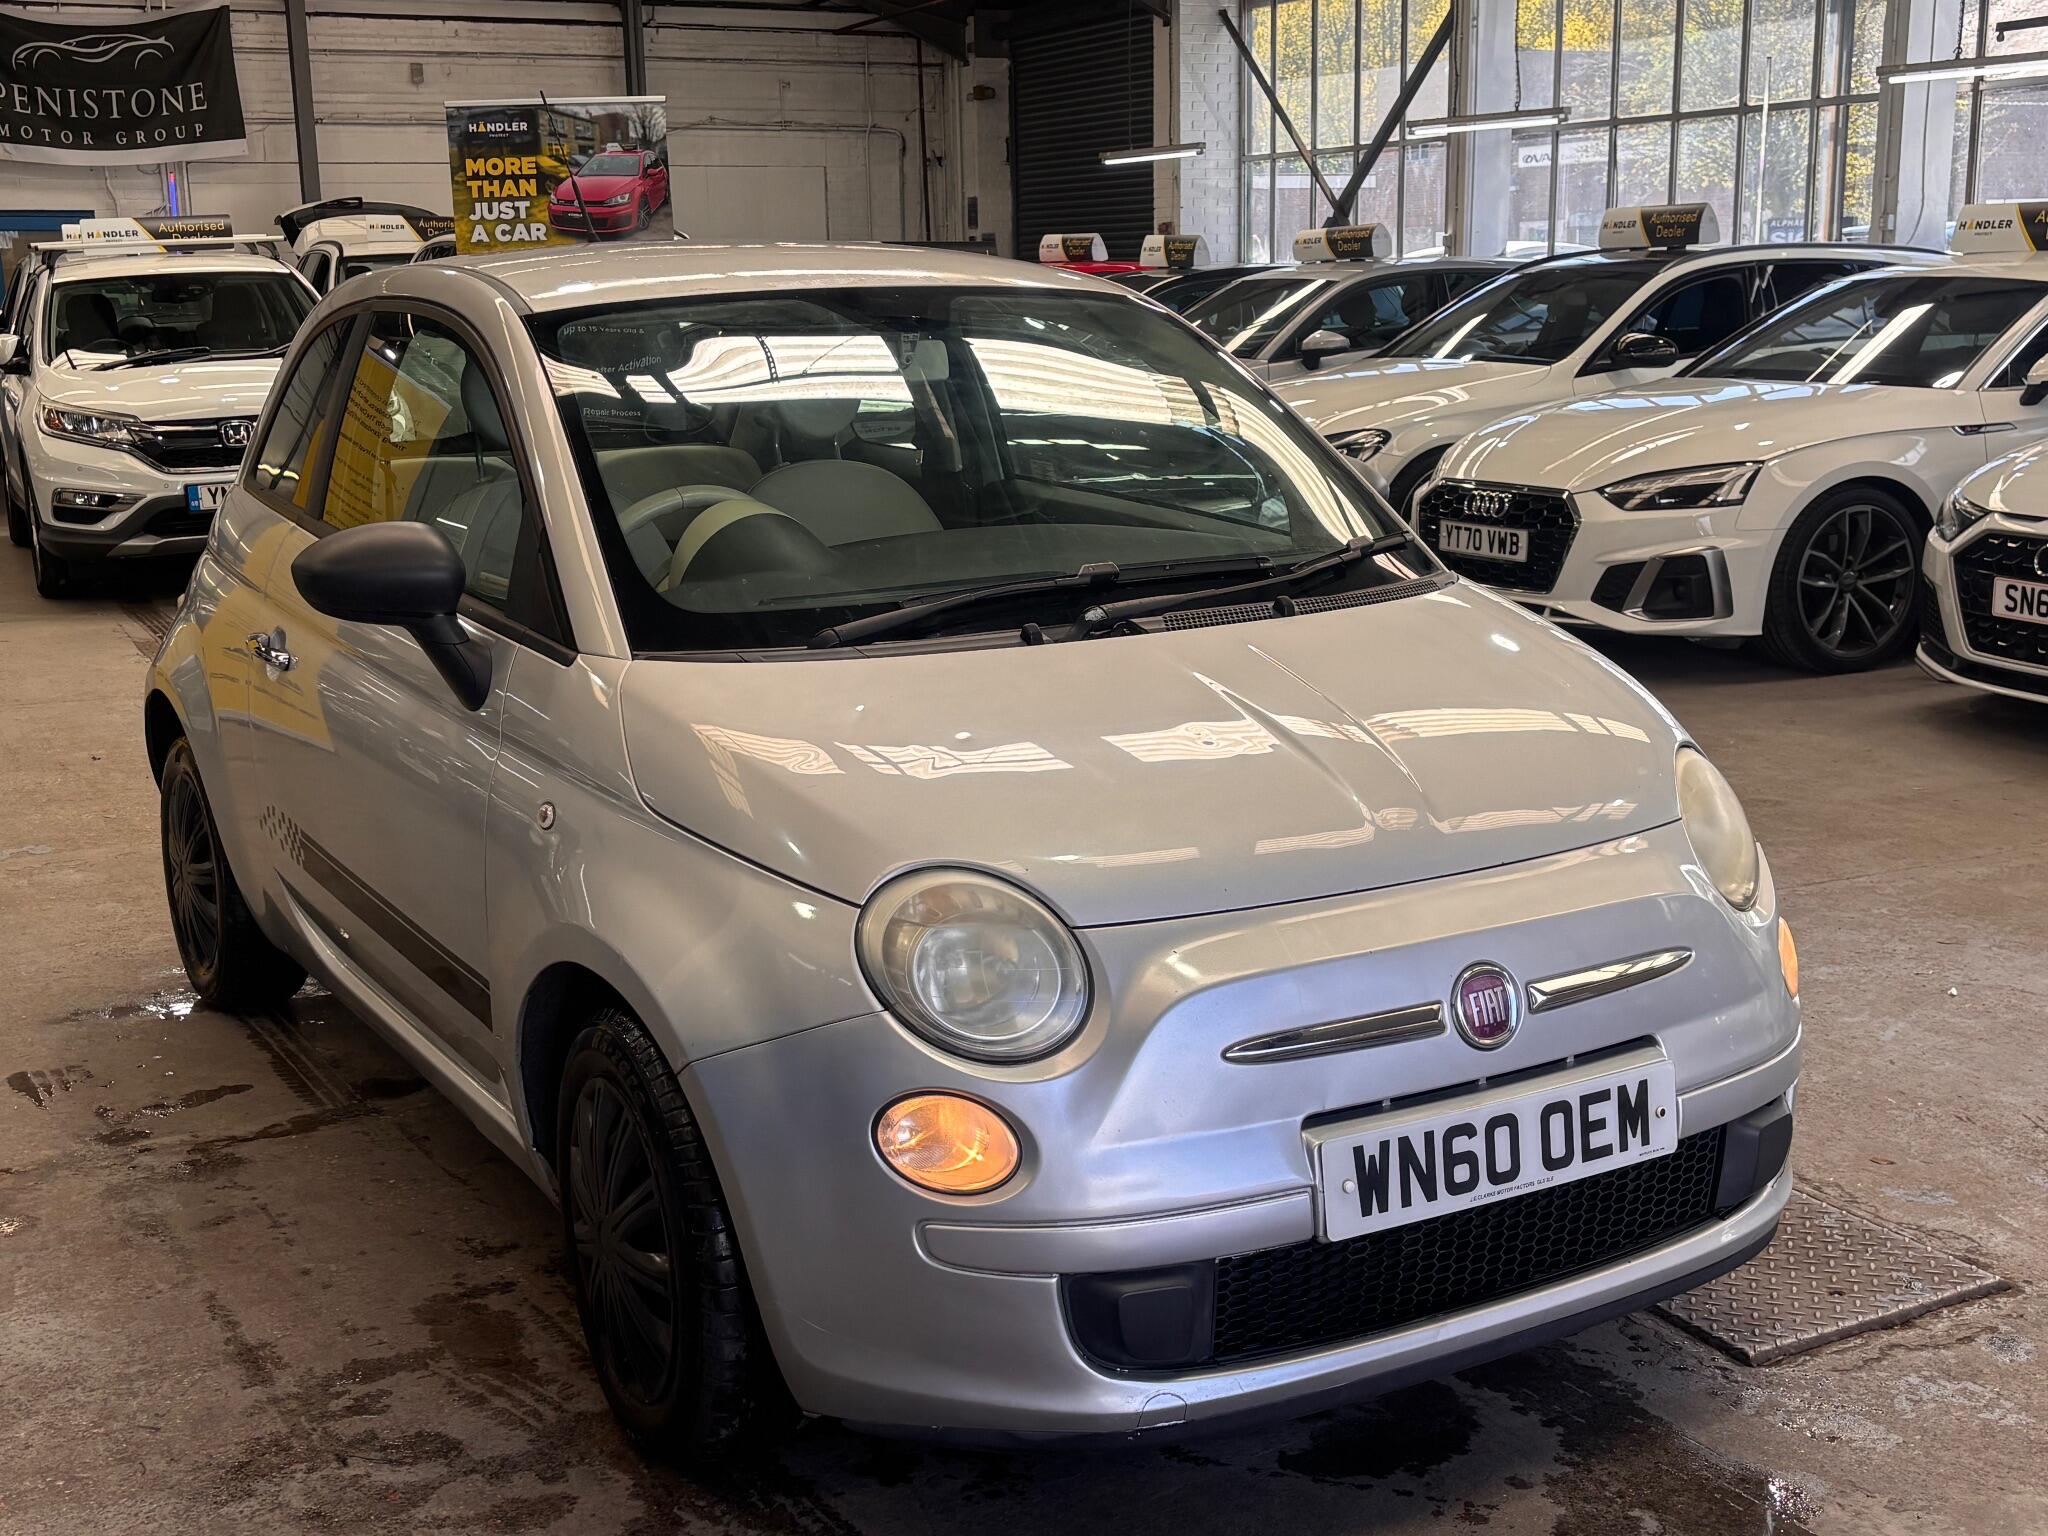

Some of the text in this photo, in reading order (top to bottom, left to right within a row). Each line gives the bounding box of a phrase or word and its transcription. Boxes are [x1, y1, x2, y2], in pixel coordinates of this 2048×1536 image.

[0, 123, 205, 145] MOTOR GROUP
[465, 156, 537, 177] MORE
[466, 179, 537, 198] THAN
[469, 201, 530, 221] JUST
[1650, 209, 1699, 224] Authorised
[159, 219, 225, 233] Authorised
[419, 218, 455, 229] Authoris
[470, 224, 490, 243] A
[494, 222, 548, 242] CAR
[1656, 225, 1686, 238] Dealer
[1332, 229, 1370, 240] Authorised
[1338, 240, 1361, 251] Dealer
[618, 354, 662, 372] Activation
[611, 409, 641, 417] Process
[1445, 524, 1520, 556] YT70 VWB
[1468, 986, 1506, 1028] FIAT
[1352, 1078, 1650, 1218] WN60 OEM
